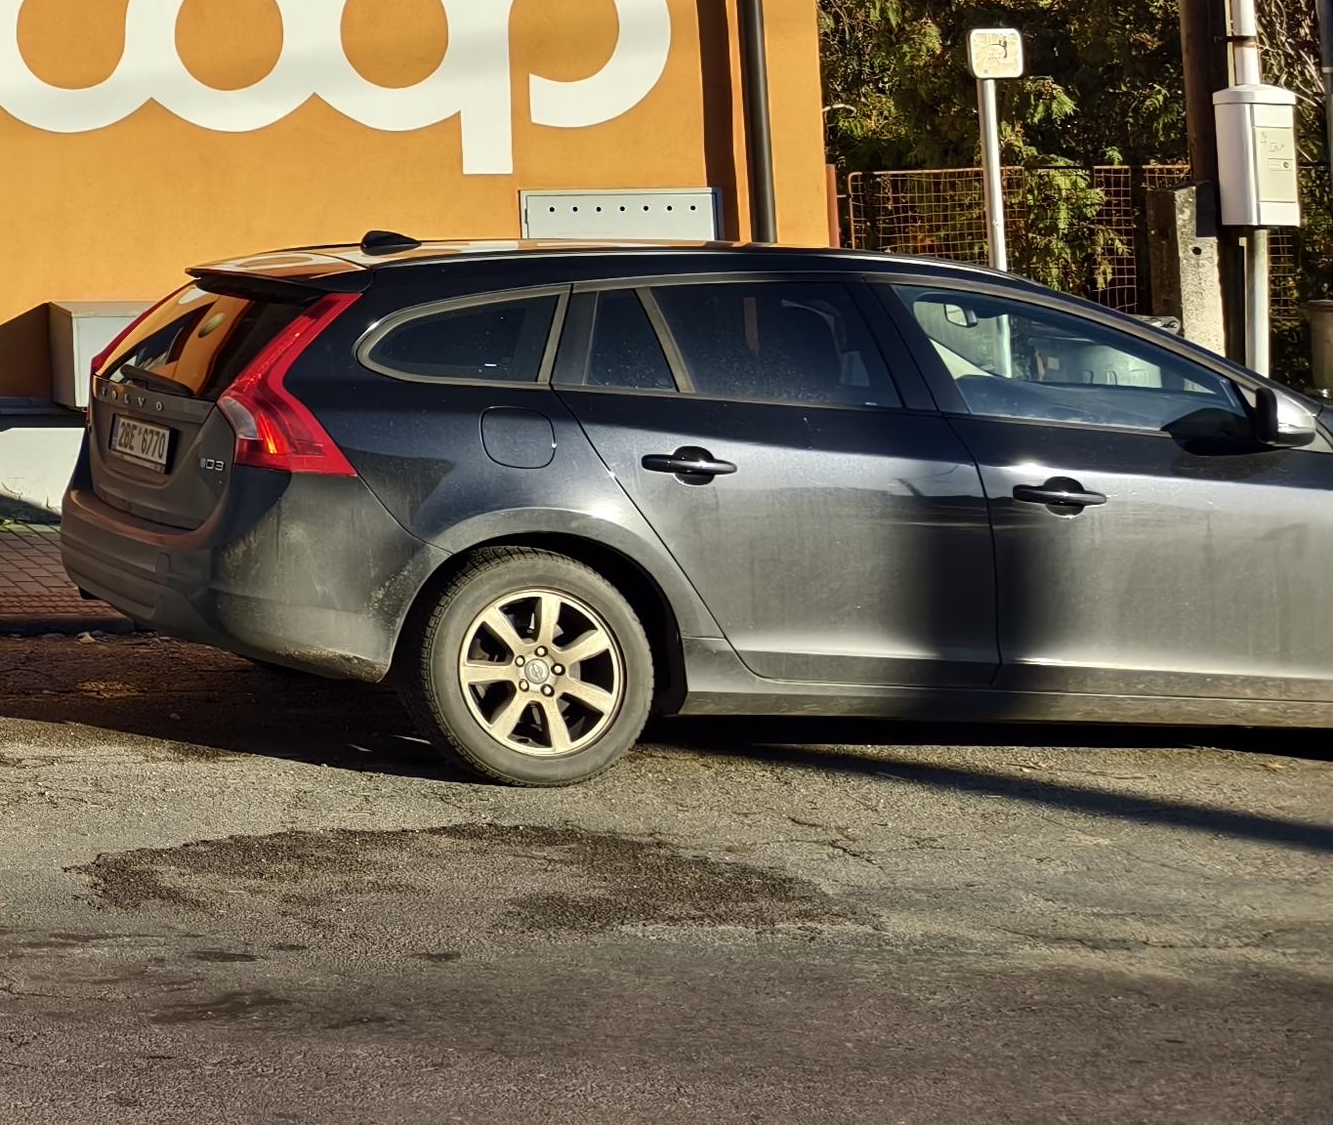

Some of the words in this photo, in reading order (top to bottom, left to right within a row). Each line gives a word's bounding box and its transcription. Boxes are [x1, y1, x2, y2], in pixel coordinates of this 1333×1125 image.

[101, 386, 163, 411] VOLVO
[117, 421, 137, 452] 2BE
[140, 427, 166, 460] 6770
[205, 458, 225, 471] D3
